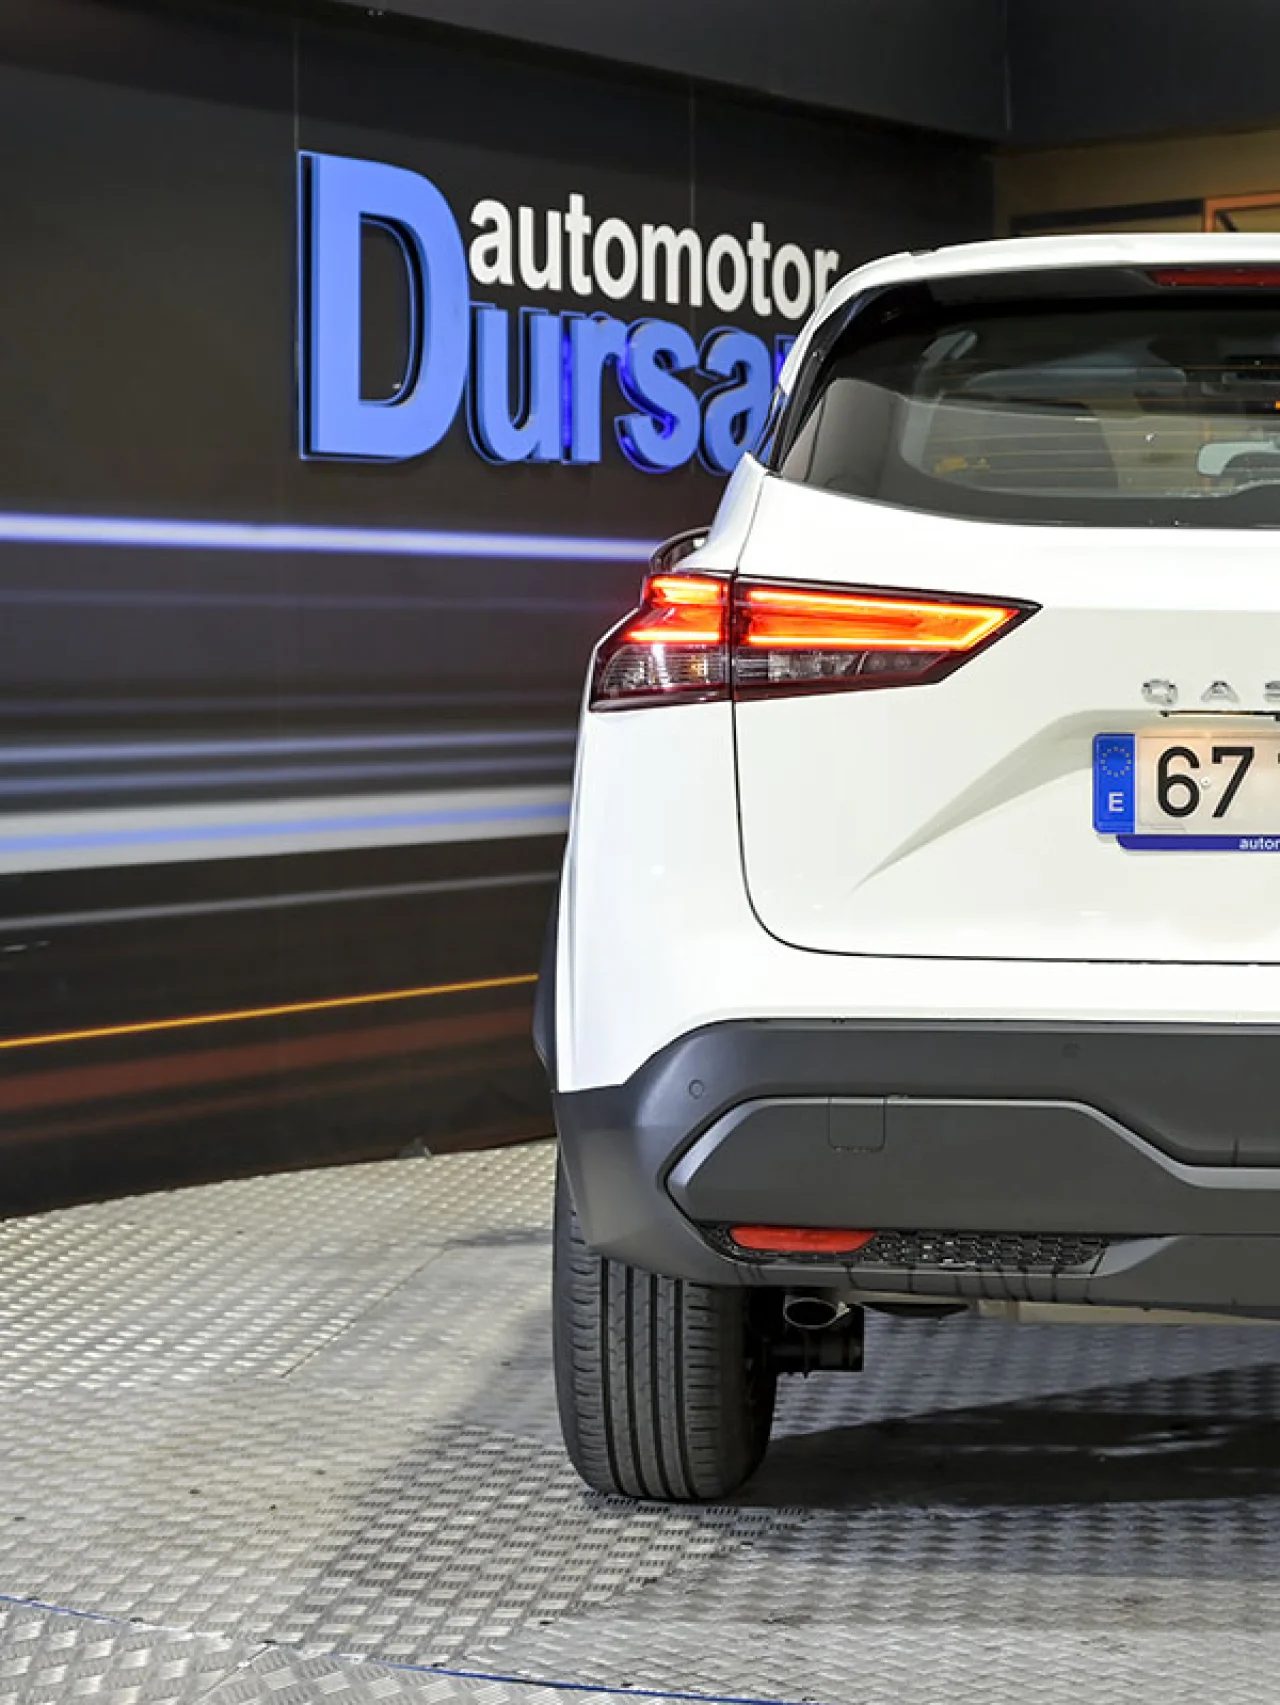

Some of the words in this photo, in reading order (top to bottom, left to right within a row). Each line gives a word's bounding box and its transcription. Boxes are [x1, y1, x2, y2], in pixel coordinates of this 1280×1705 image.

[298, 150, 802, 474] Dursa
[468, 193, 840, 320] automotor
[1108, 793, 1125, 812] E
